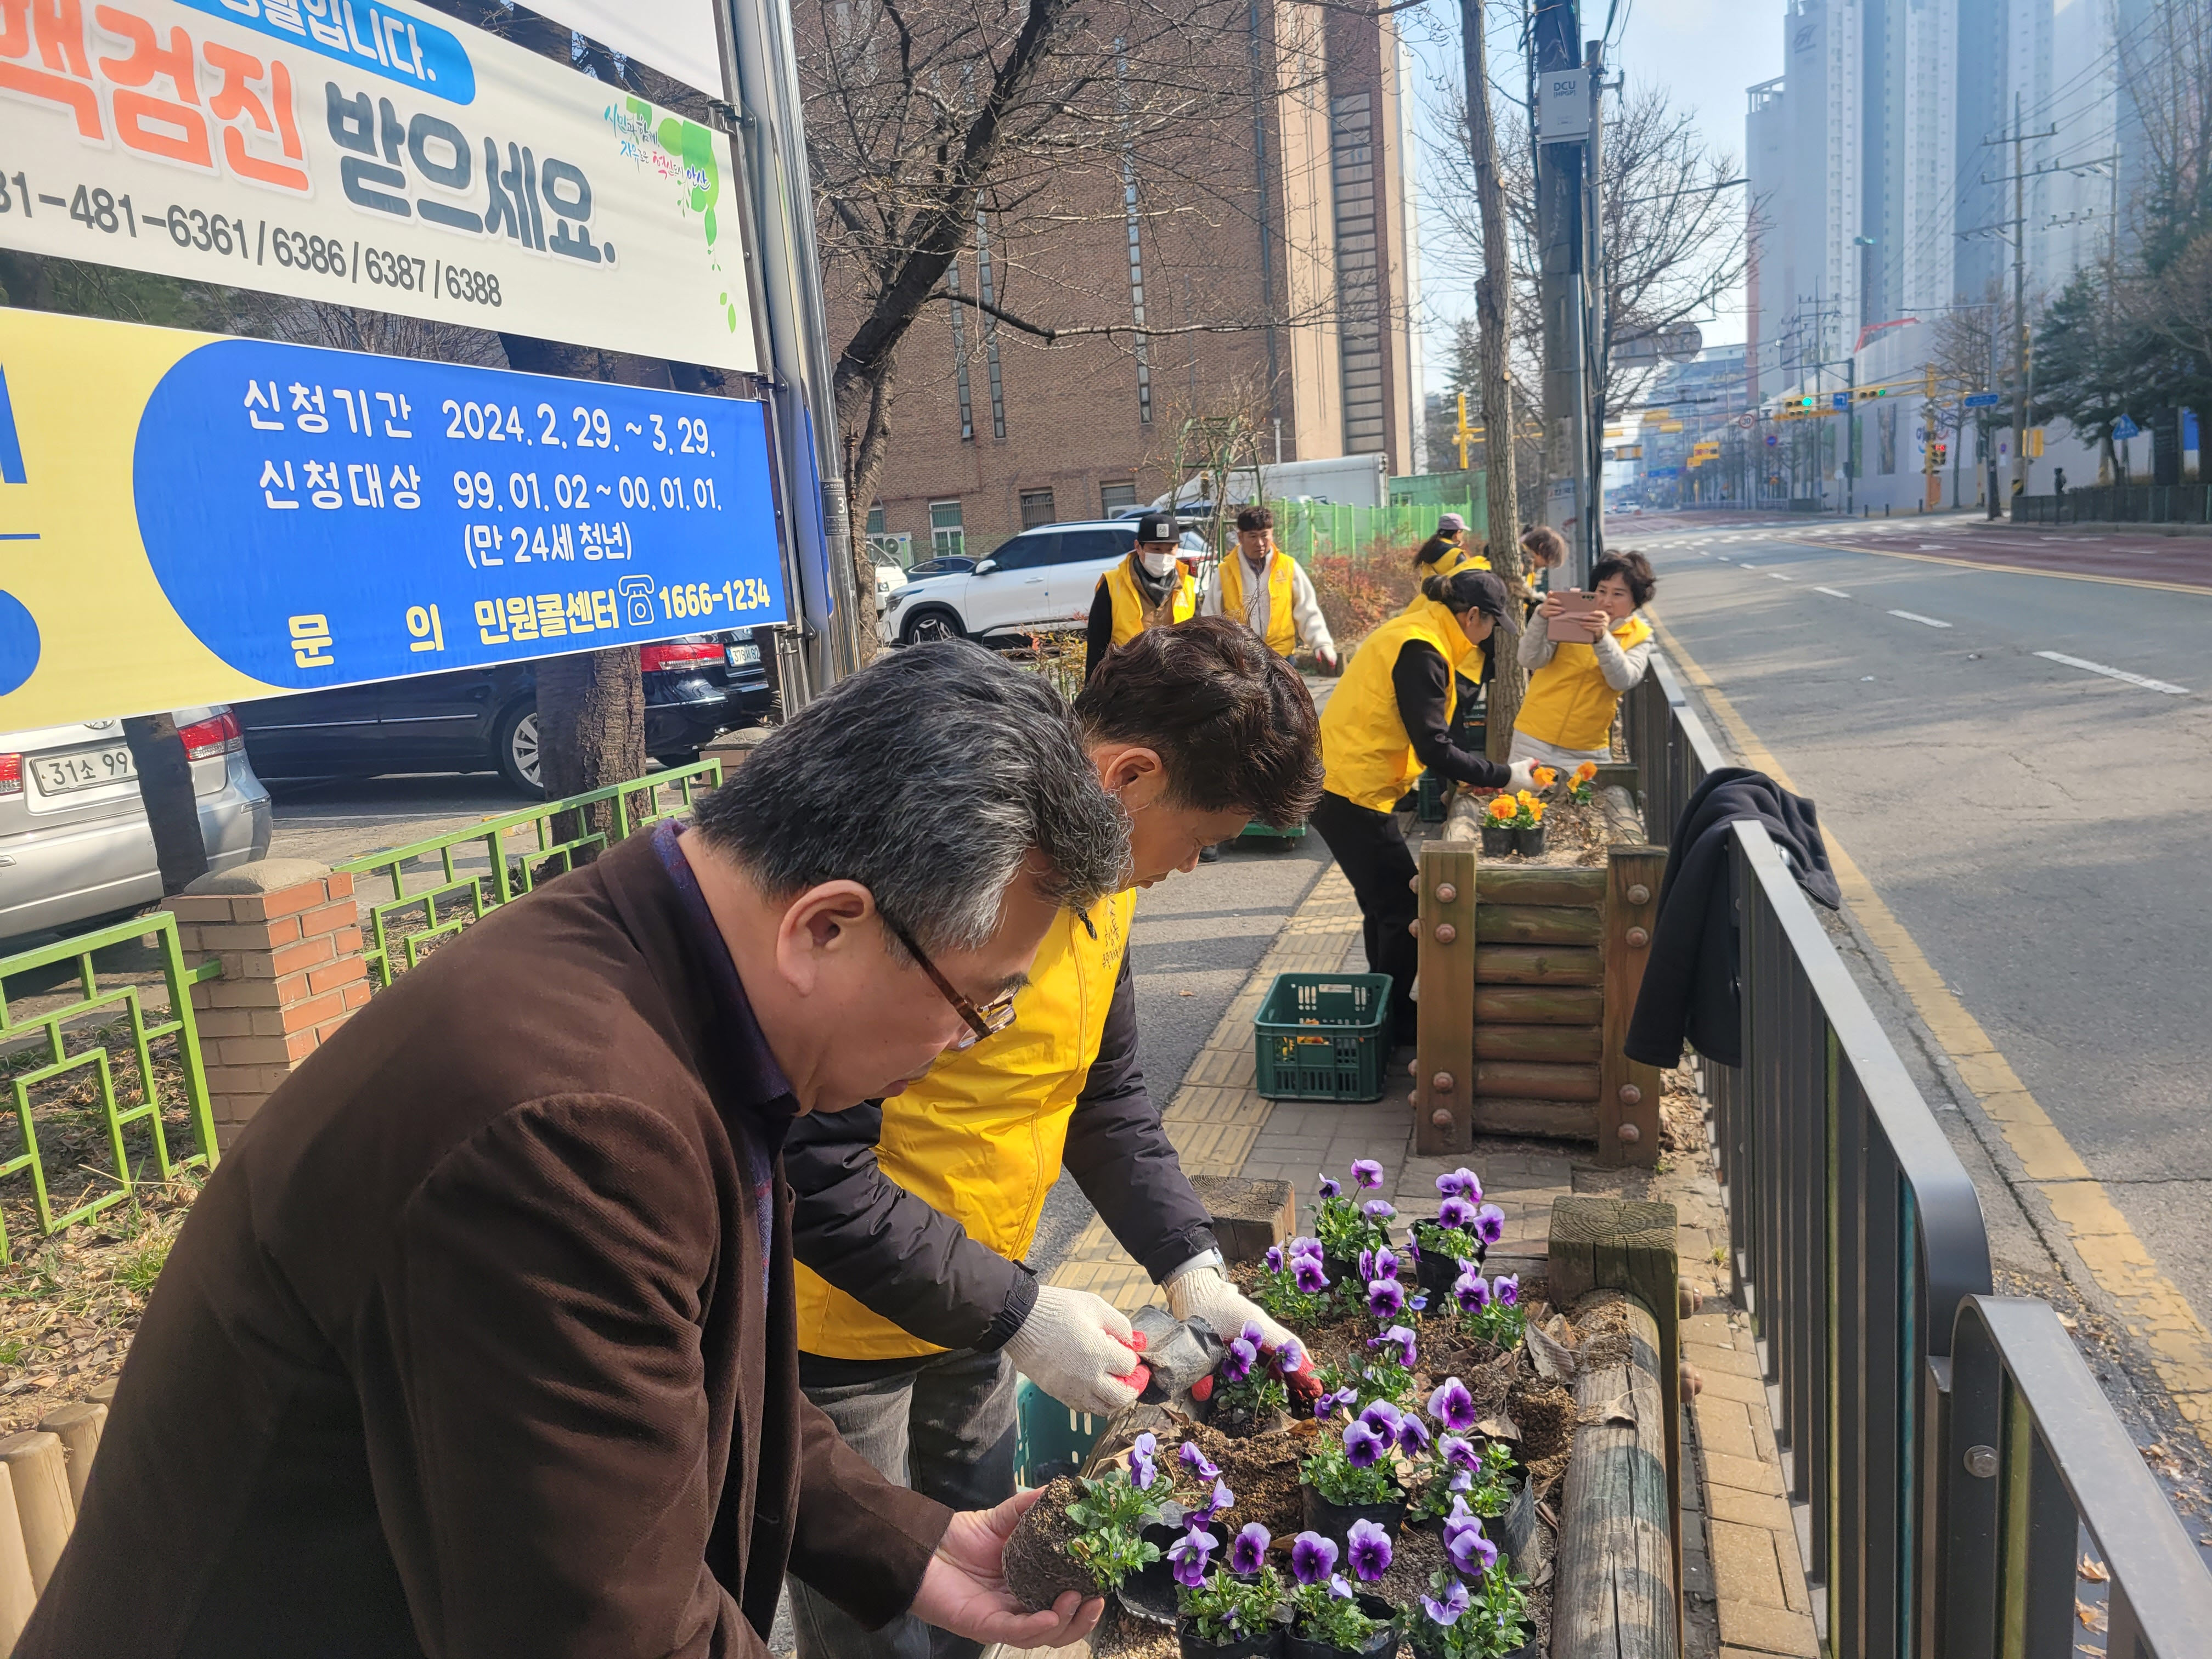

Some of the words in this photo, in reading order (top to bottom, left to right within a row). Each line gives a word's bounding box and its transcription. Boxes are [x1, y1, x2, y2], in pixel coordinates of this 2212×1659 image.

[1554, 81, 1576, 92] DCU
[325, 81, 616, 263] 받으세요.
[687, 164, 711, 190] 안산
[244, 380, 412, 439] 신청기간
[259, 460, 421, 510] 신청대상
[465, 524, 504, 569] (만
[511, 523, 575, 563] 24세
[578, 521, 632, 561] 청년)
[475, 589, 620, 645] 민원콜센터
[658, 578, 770, 620] 1666-1234
[48, 759, 97, 786] 31소
